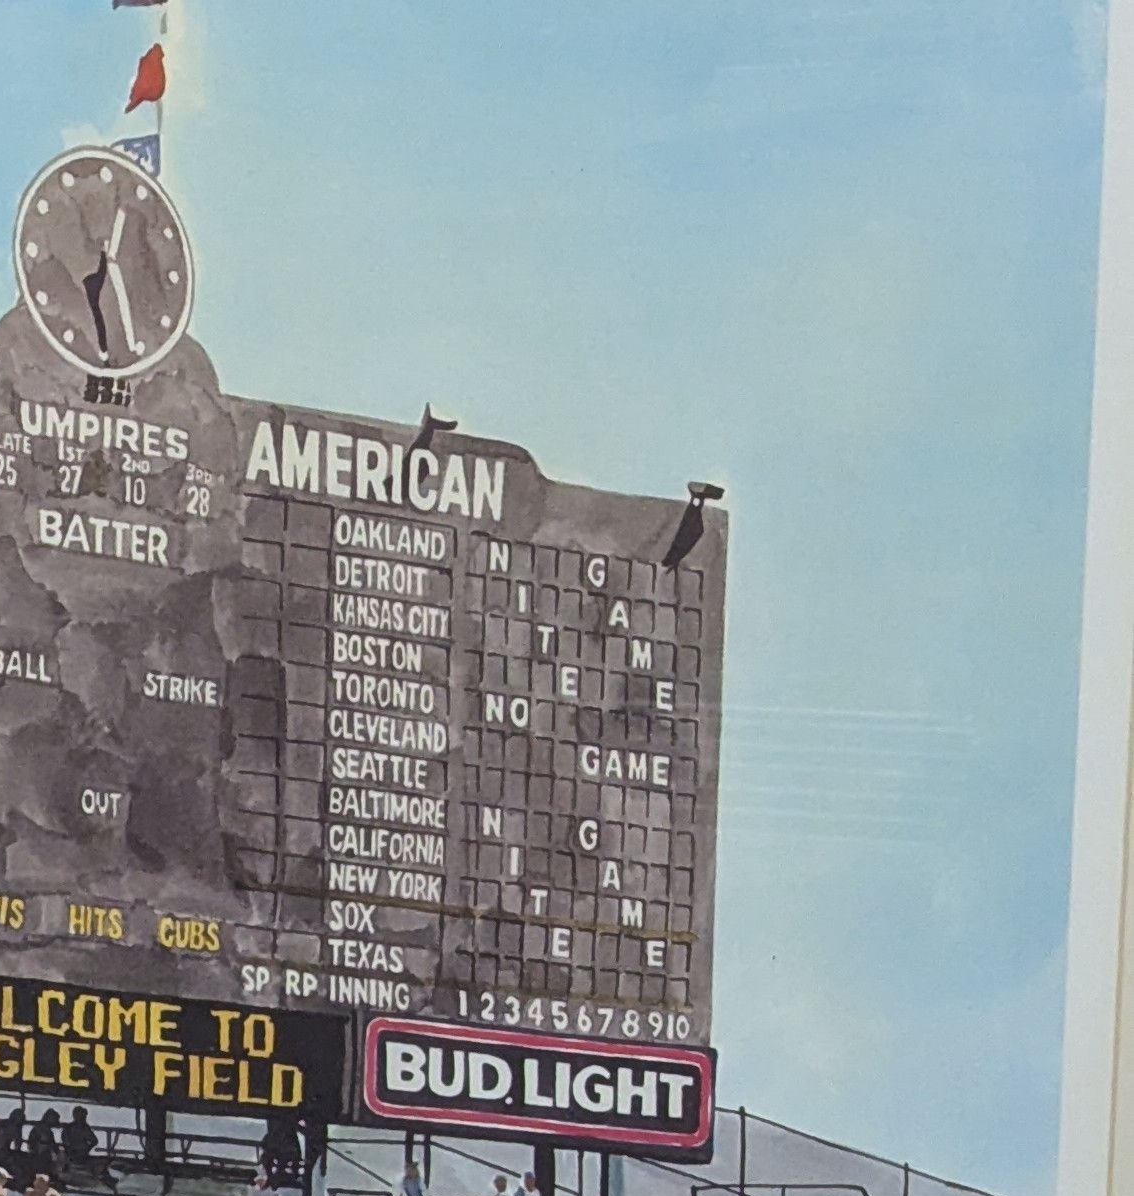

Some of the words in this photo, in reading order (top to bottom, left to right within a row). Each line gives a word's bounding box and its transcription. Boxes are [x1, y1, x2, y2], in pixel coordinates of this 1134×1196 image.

[20, 401, 189, 460] UMPIRES
[58, 439, 84, 462] 1ST
[121, 453, 151, 474] 2ND
[246, 420, 506, 521] AMERICAN
[59, 465, 82, 495] 27
[124, 475, 146, 505] 10
[186, 485, 210, 517] 28
[39, 509, 169, 567] BATTER
[335, 515, 446, 561] OAKLAND
[335, 555, 428, 597] DETROIT
[333, 593, 404, 631] KANSAS
[408, 605, 450, 638] CITY
[333, 632, 422, 673] BOSTON
[144, 672, 217, 705] STRIKE
[331, 669, 434, 714] TORONTO
[329, 709, 447, 753] CLEVELAND
[331, 746, 428, 790] SEATTLE
[580, 745, 670, 787] GAME
[81, 789, 122, 818] OUT
[329, 787, 445, 829] BALTIMORE
[329, 824, 444, 867] CALIFORNIA
[328, 862, 378, 894] NEW
[388, 869, 442, 903] YORK
[69, 904, 123, 940] HITS
[159, 917, 221, 952] CUBS
[329, 901, 377, 934] SOX
[328, 938, 405, 974] TEXAS
[242, 964, 269, 994] SP
[285, 973, 318, 999] RP
[330, 975, 411, 1012] INNING
[211, 1009, 276, 1058] TO
[152, 1051, 304, 1107] FIELD
[523, 1057, 694, 1119] LIGHT
